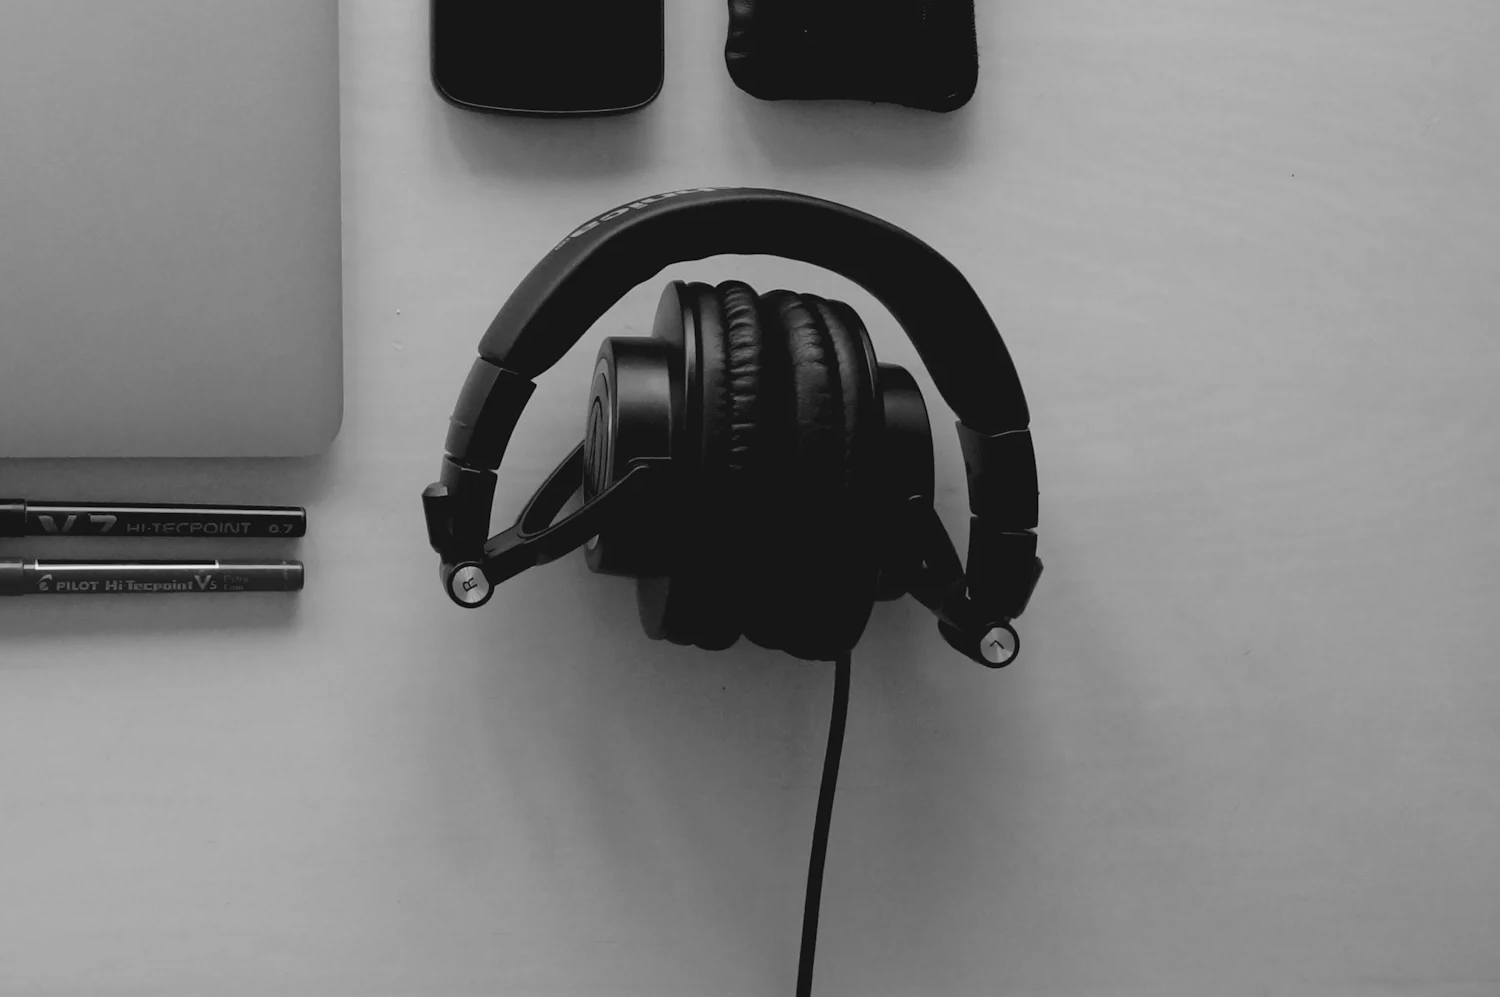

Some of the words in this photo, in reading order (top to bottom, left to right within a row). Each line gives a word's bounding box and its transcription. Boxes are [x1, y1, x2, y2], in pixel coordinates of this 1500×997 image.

[268, 523, 293, 534] 0.7
[56, 580, 99, 591] PILOT
[462, 576, 478, 592] R
